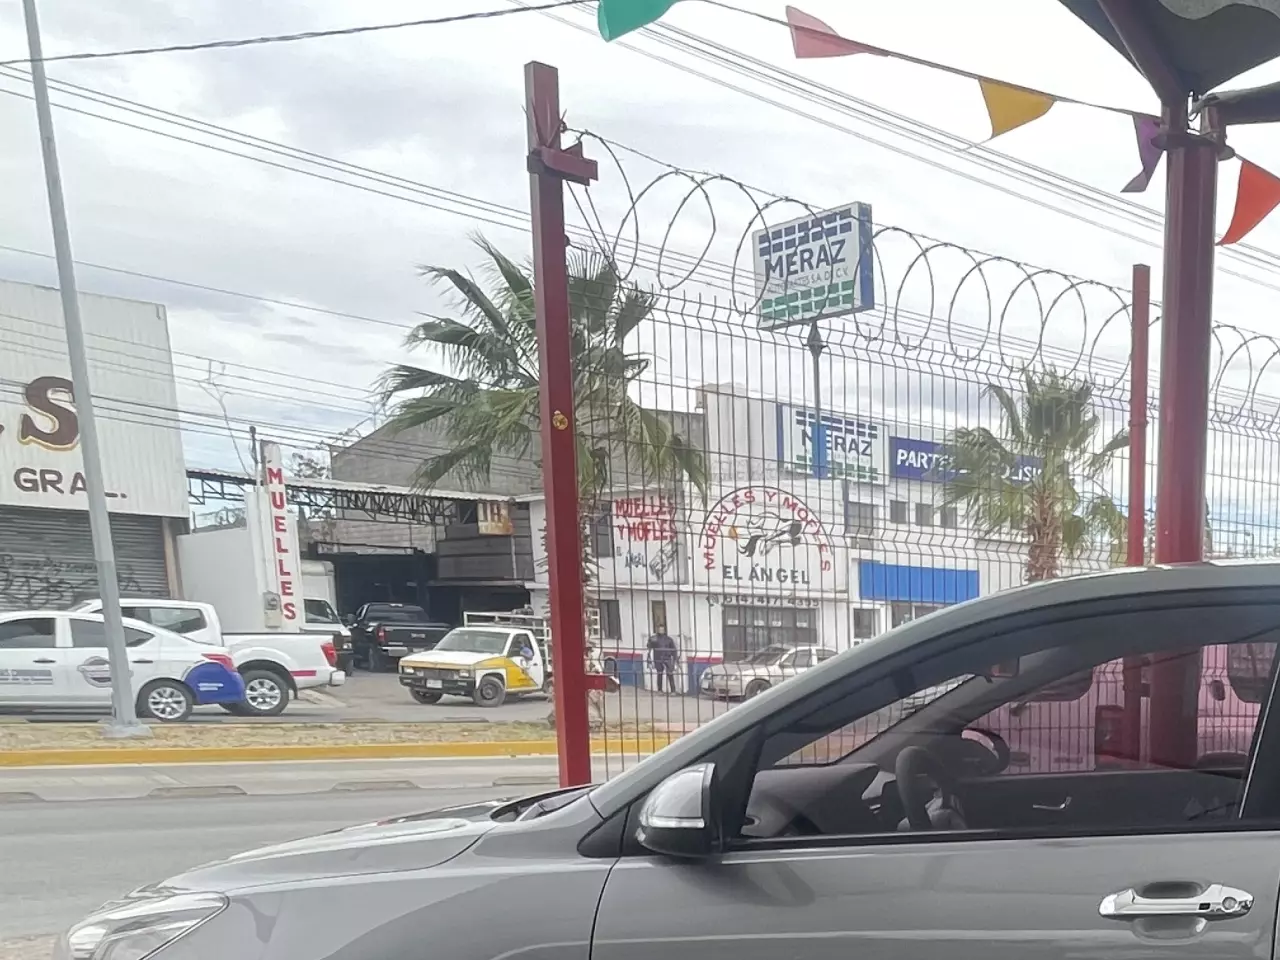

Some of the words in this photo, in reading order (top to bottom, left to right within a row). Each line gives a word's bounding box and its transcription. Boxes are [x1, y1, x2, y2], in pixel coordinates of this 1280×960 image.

[765, 238, 846, 279] MERAZ
[0, 375, 82, 452] S
[13, 466, 128, 500] GRA.
[615, 494, 677, 519] MUELLES
[266, 467, 297, 621] MUELLES
[616, 524, 625, 541] Y
[629, 520, 677, 542] MOFLES
[703, 490, 756, 570] MUELLES
[764, 490, 778, 502] Y
[722, 565, 743, 581] EL
[748, 562, 811, 584] ÁNGEL
